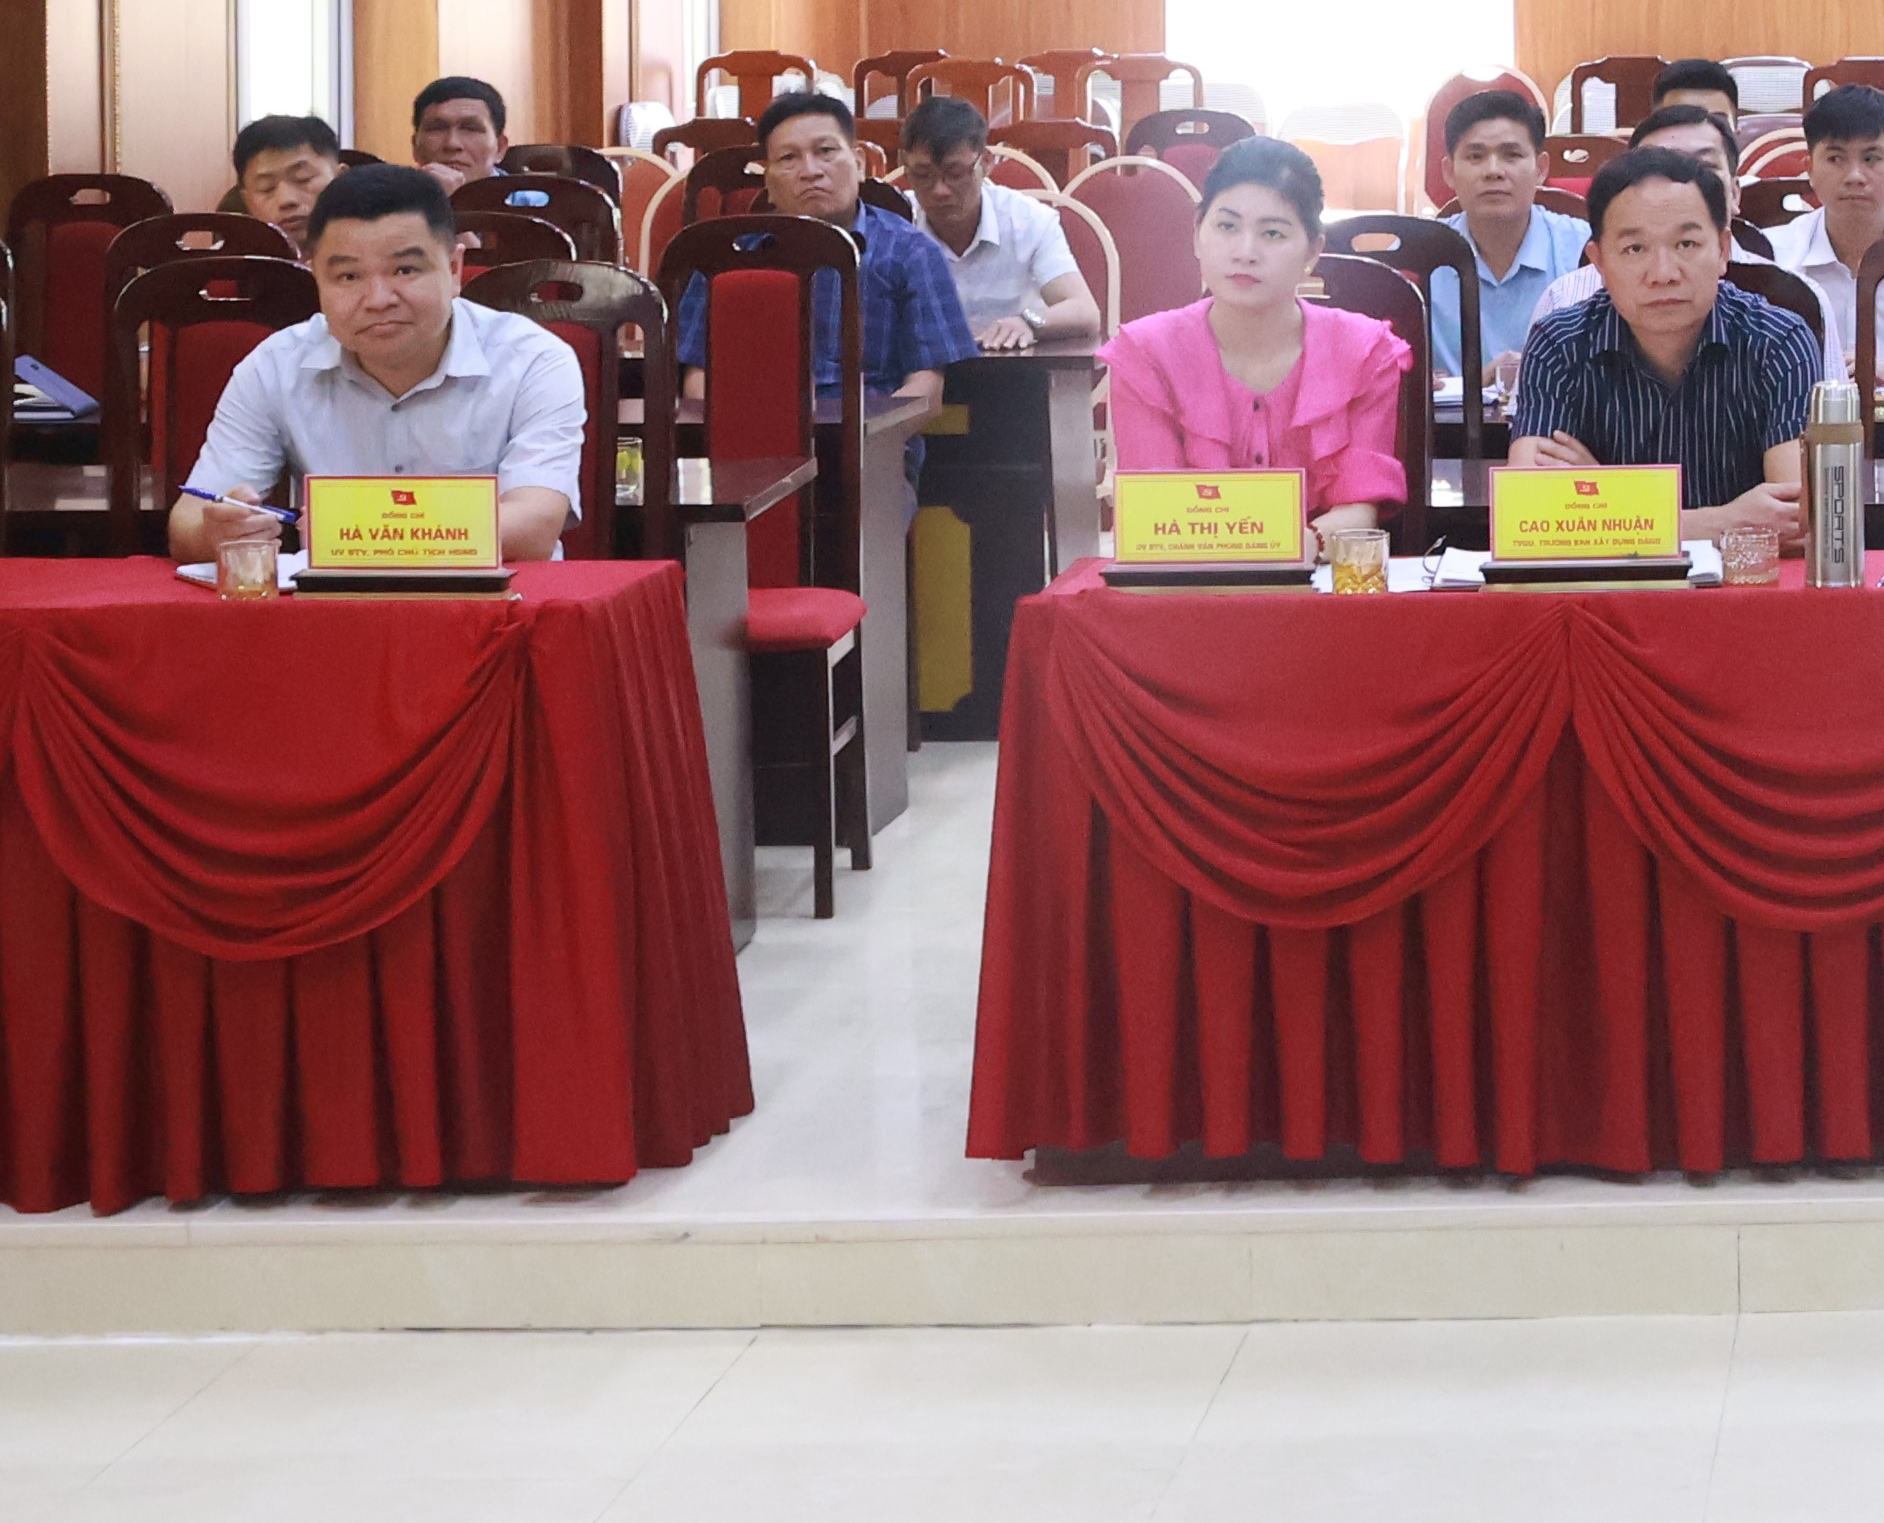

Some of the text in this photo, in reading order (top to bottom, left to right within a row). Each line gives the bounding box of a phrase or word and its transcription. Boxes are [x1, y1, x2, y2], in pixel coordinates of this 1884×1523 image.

[1519, 515, 1654, 535] CAO XUÂN NHUẬN
[1834, 465, 1845, 564] SPORTS
[339, 524, 468, 541] HÀ VĂN KHÁNH
[1154, 516, 1264, 538] HÀ THỊ YẾN
